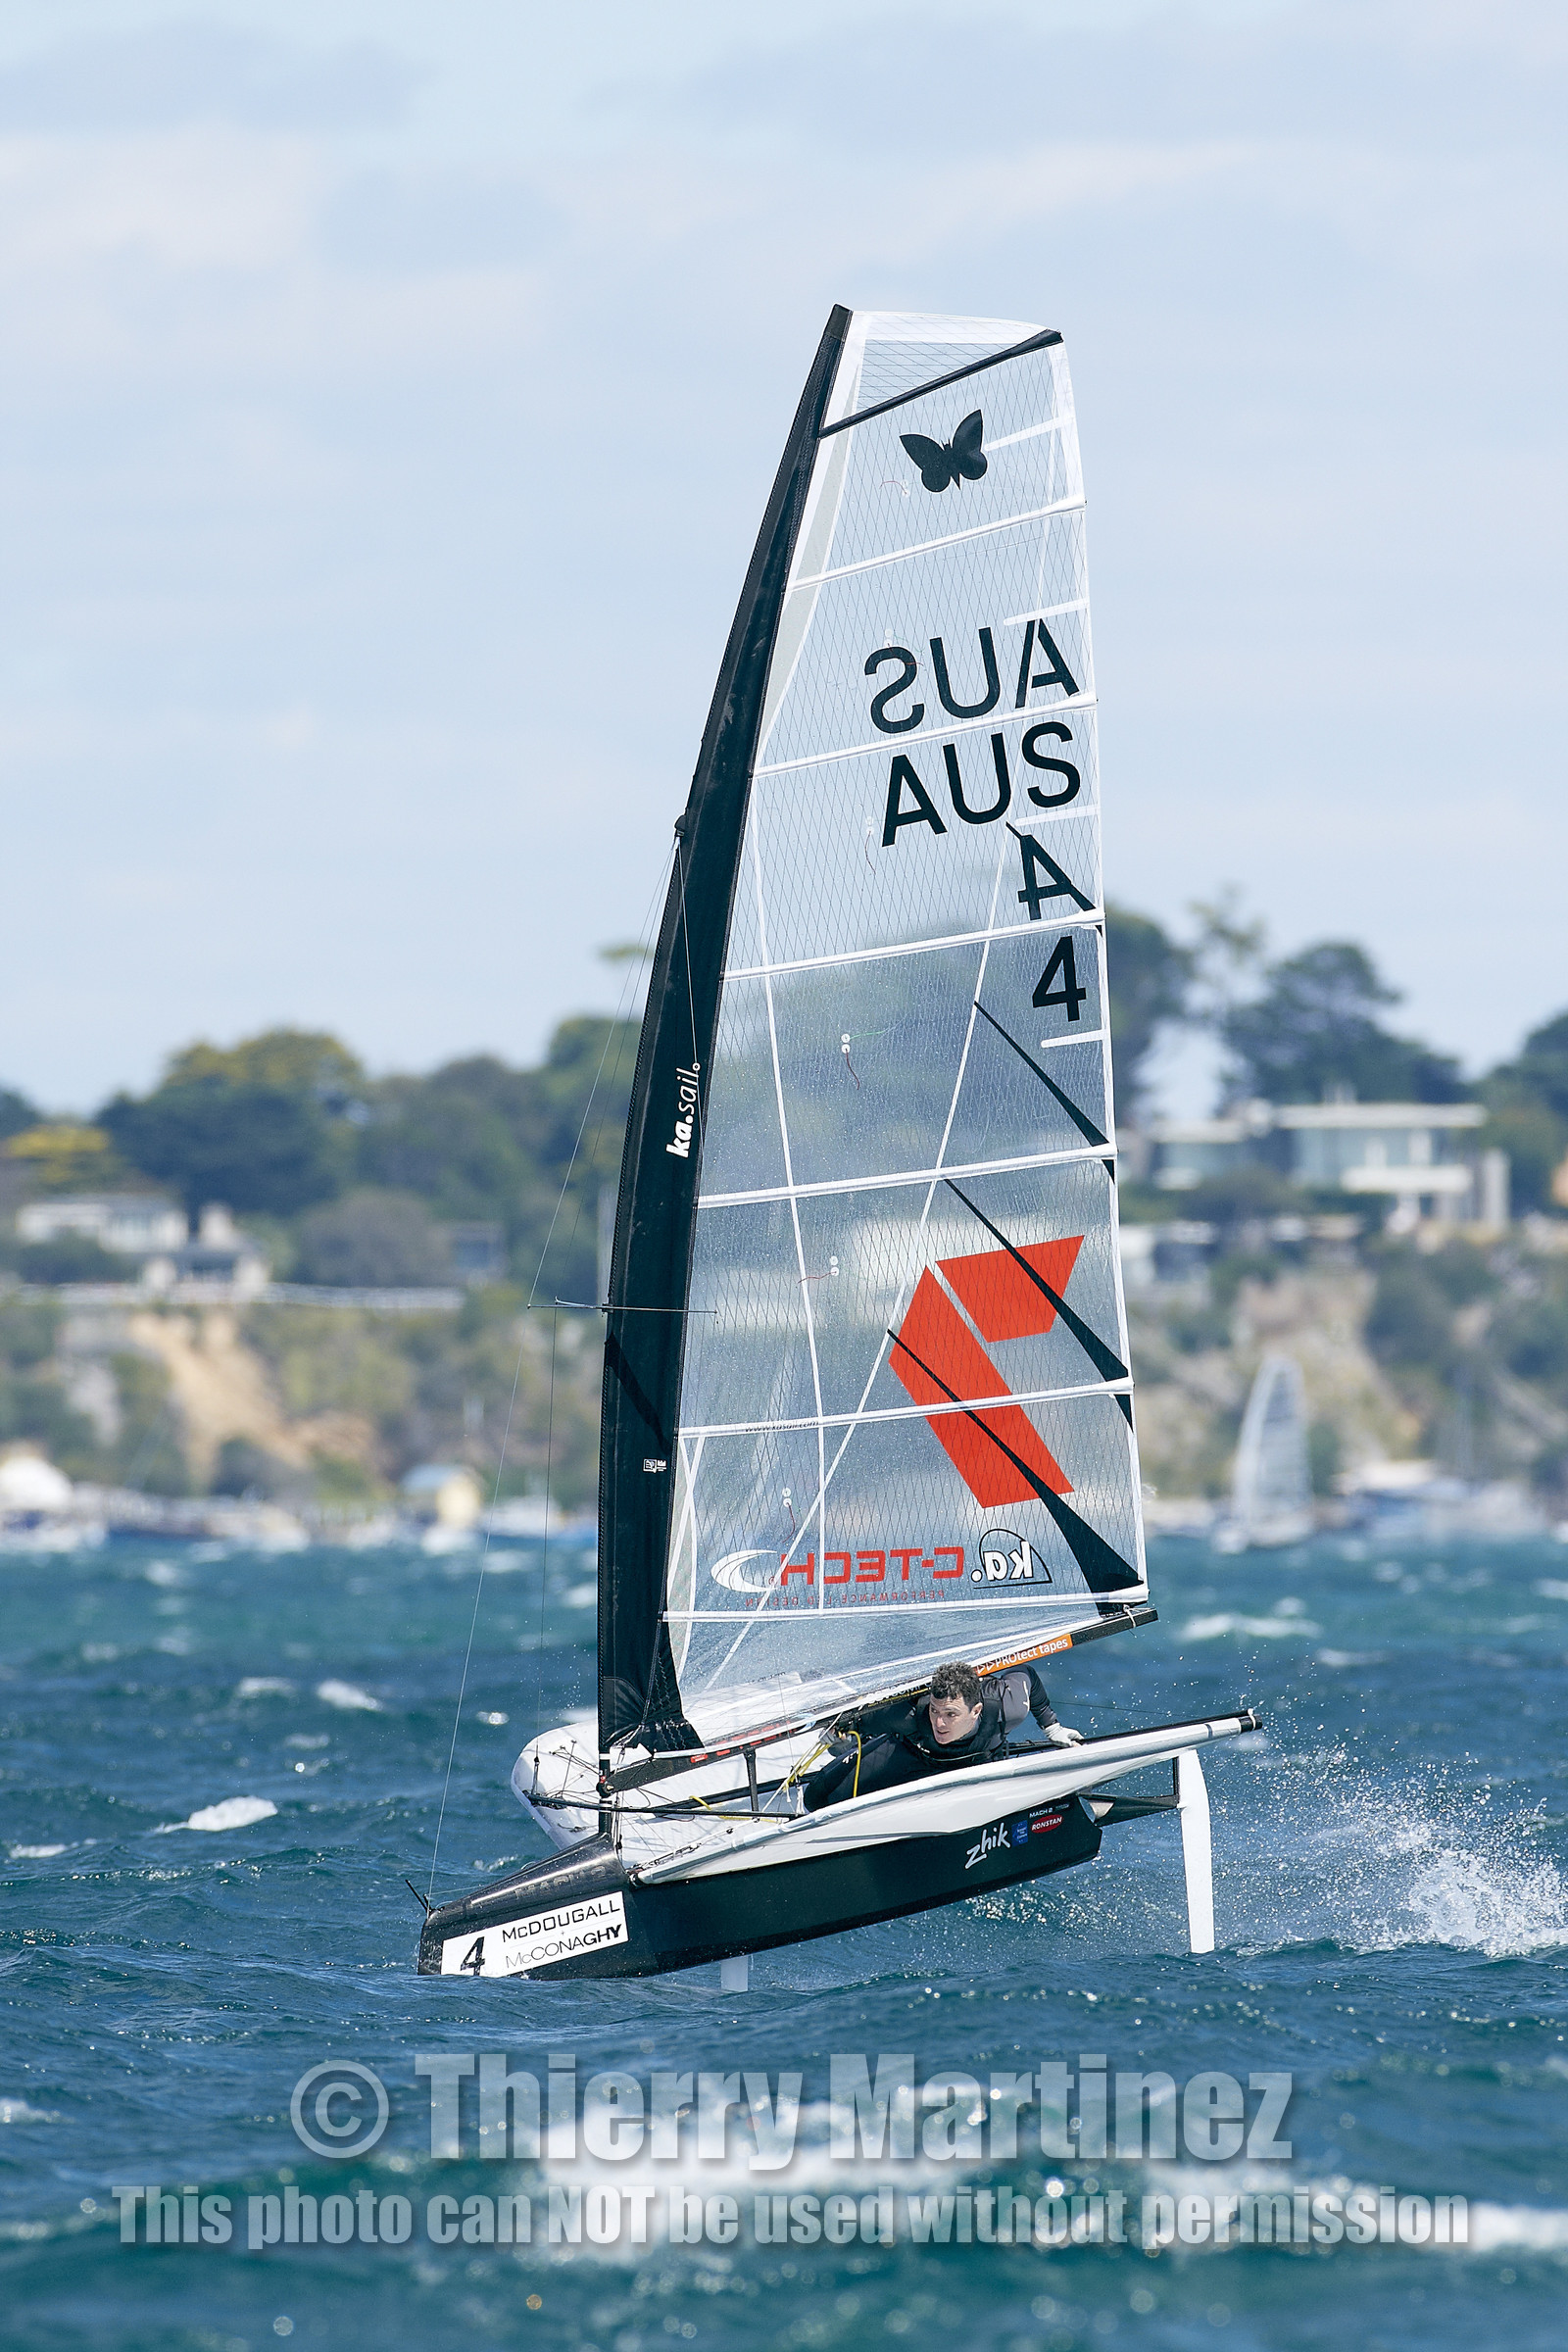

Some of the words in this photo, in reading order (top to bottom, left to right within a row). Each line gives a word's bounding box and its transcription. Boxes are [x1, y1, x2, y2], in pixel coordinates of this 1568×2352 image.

[882, 721, 1081, 847] AUS
[1033, 936, 1087, 1022] 4
[1039, 1639, 1069, 1653] tapes
[1031, 1816, 1063, 1831] RONSTAN
[460, 1936, 486, 1976] 4
